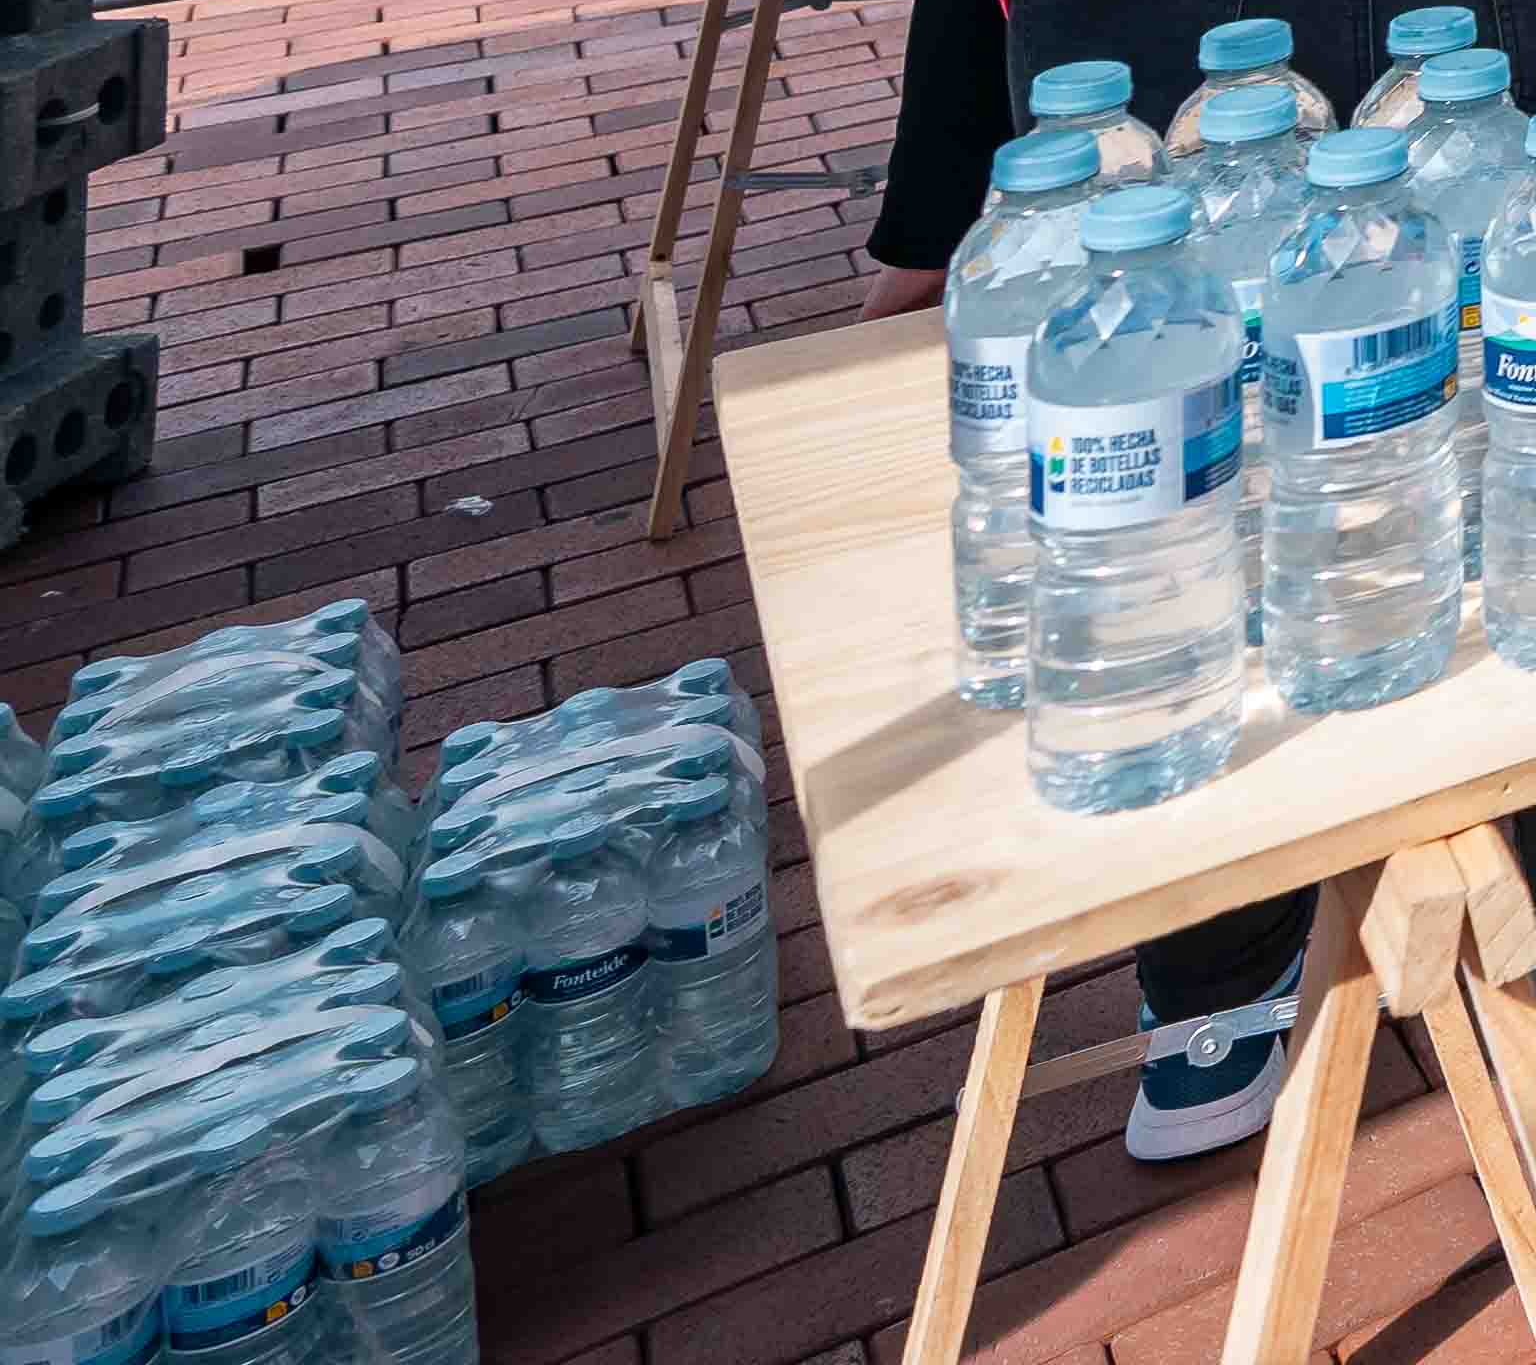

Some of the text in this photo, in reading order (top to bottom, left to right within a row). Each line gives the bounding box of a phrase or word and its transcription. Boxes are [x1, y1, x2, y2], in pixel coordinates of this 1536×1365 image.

[1071, 428, 1156, 453] 100% HECHA
[1071, 448, 1162, 473] DE BOTELLAS
[1071, 469, 1155, 495] RECICLADAS
[552, 953, 630, 991] Fonteide
